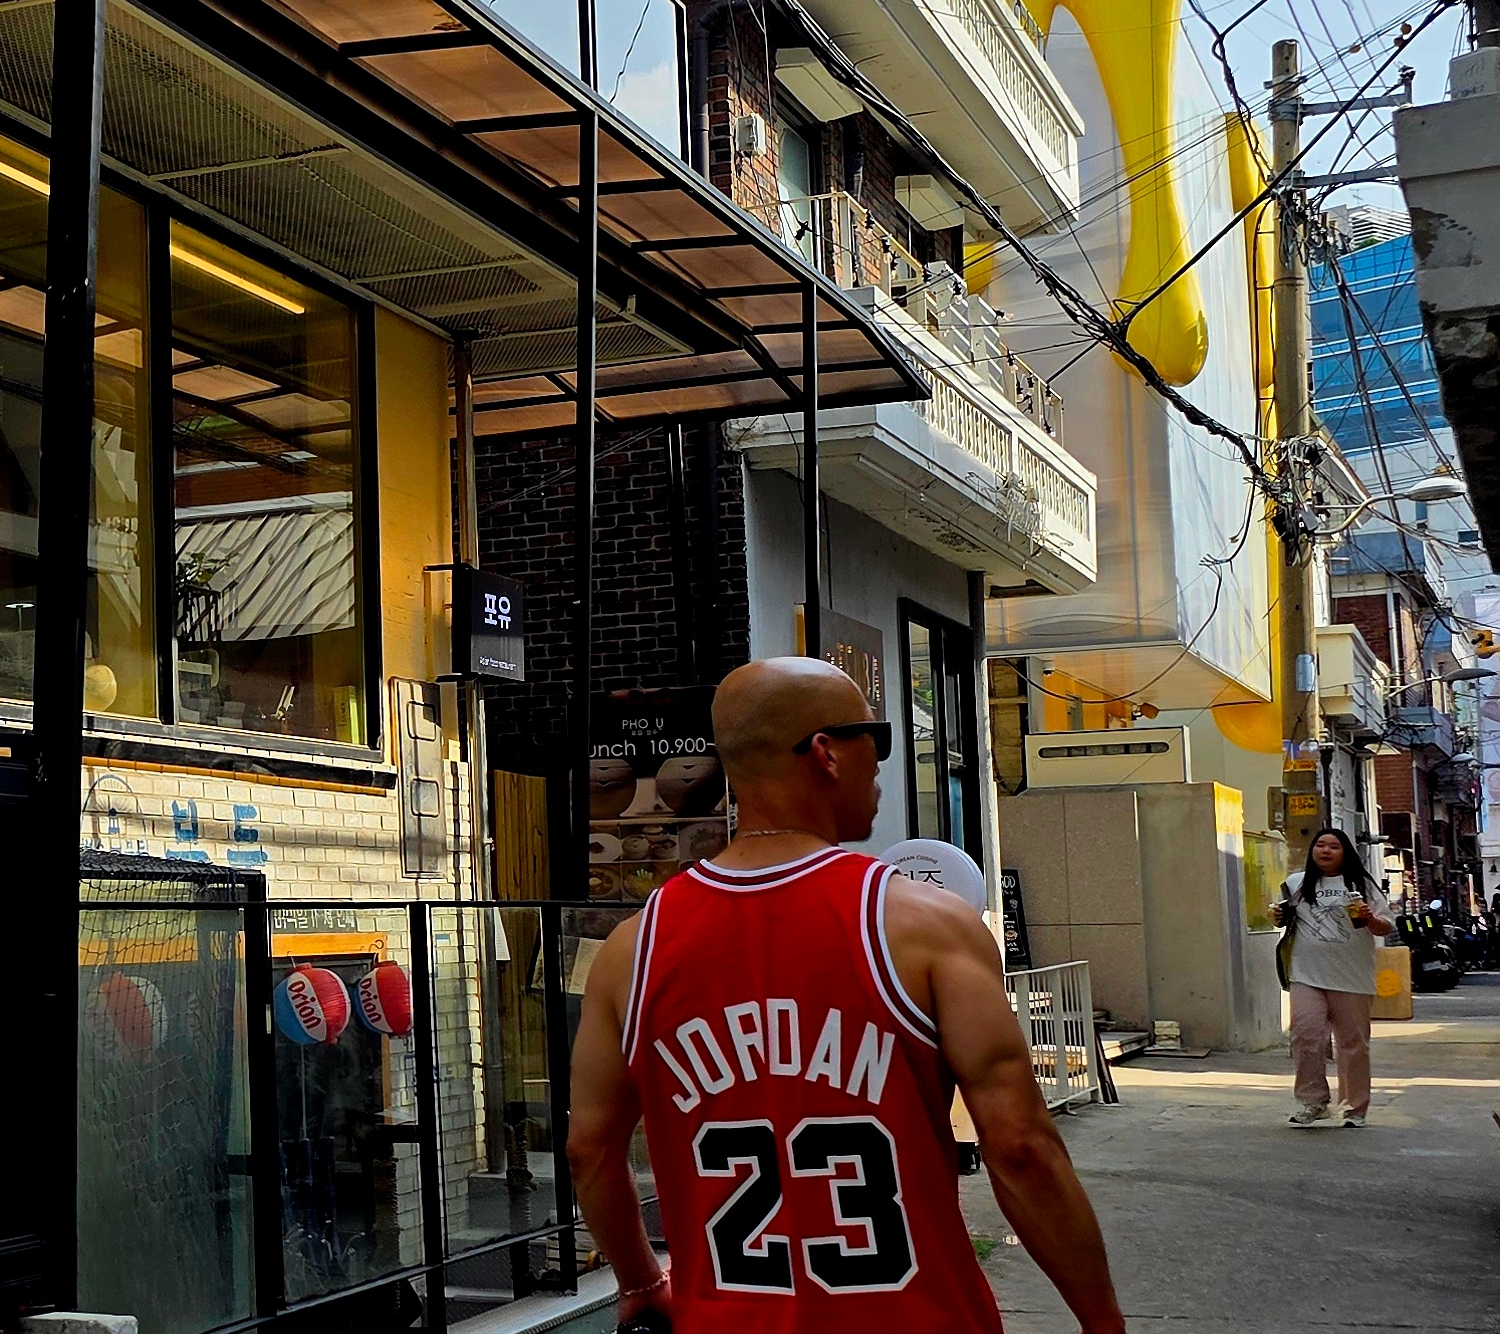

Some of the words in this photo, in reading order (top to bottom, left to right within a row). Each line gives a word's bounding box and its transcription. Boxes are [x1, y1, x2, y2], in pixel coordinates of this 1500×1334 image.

[484, 592, 512, 630] 포유
[622, 718, 649, 730] PHO
[652, 996, 895, 1114] JORDAN
[692, 1115, 920, 1297] 23
